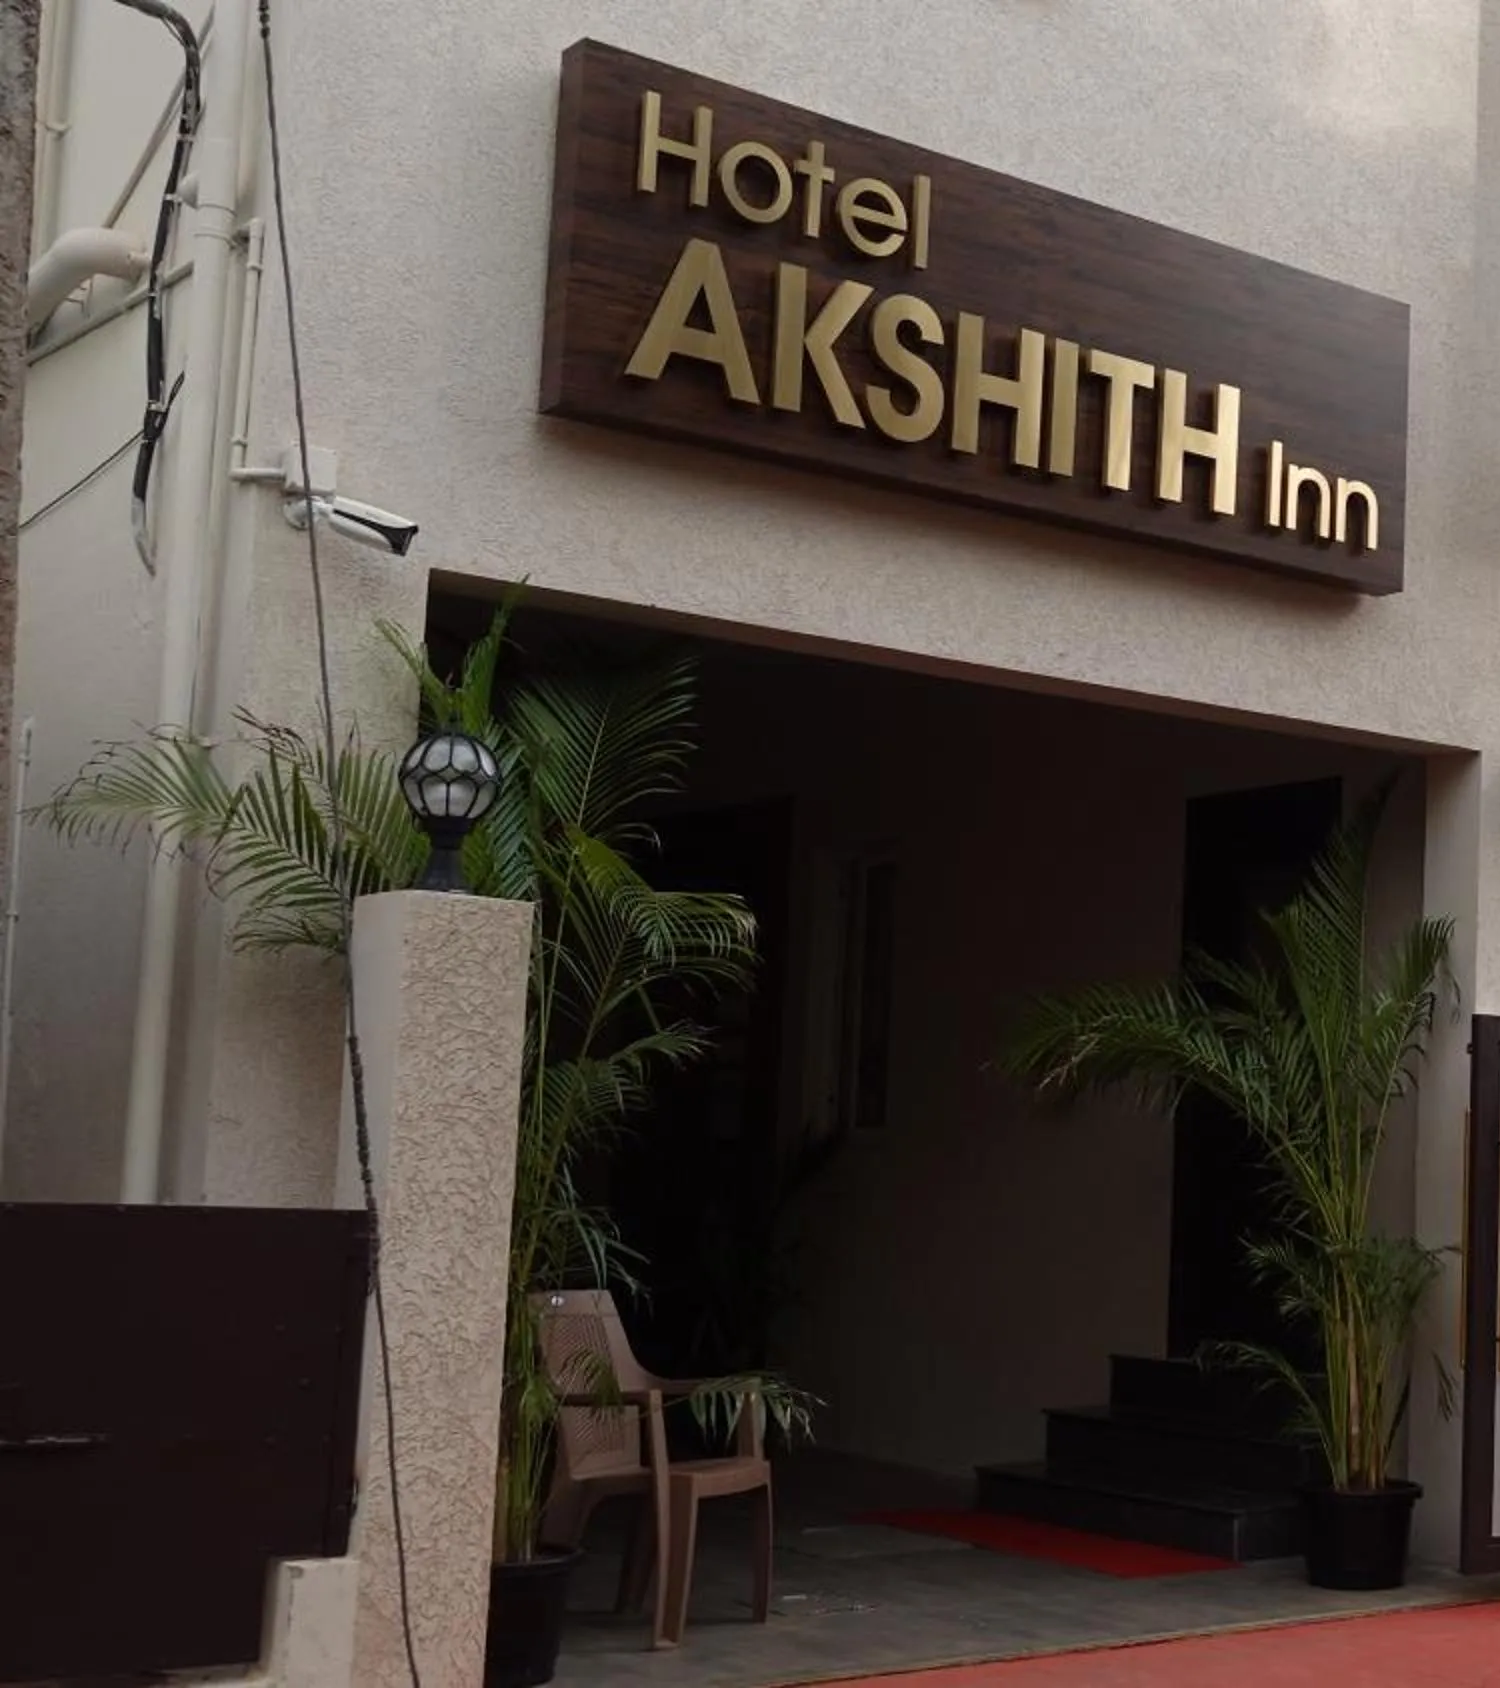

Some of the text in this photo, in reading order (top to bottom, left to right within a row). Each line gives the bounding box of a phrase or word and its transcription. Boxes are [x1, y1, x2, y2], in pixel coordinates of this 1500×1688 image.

[637, 91, 931, 269] Hotel
[624, 238, 1380, 552] AKSHITH Inn
